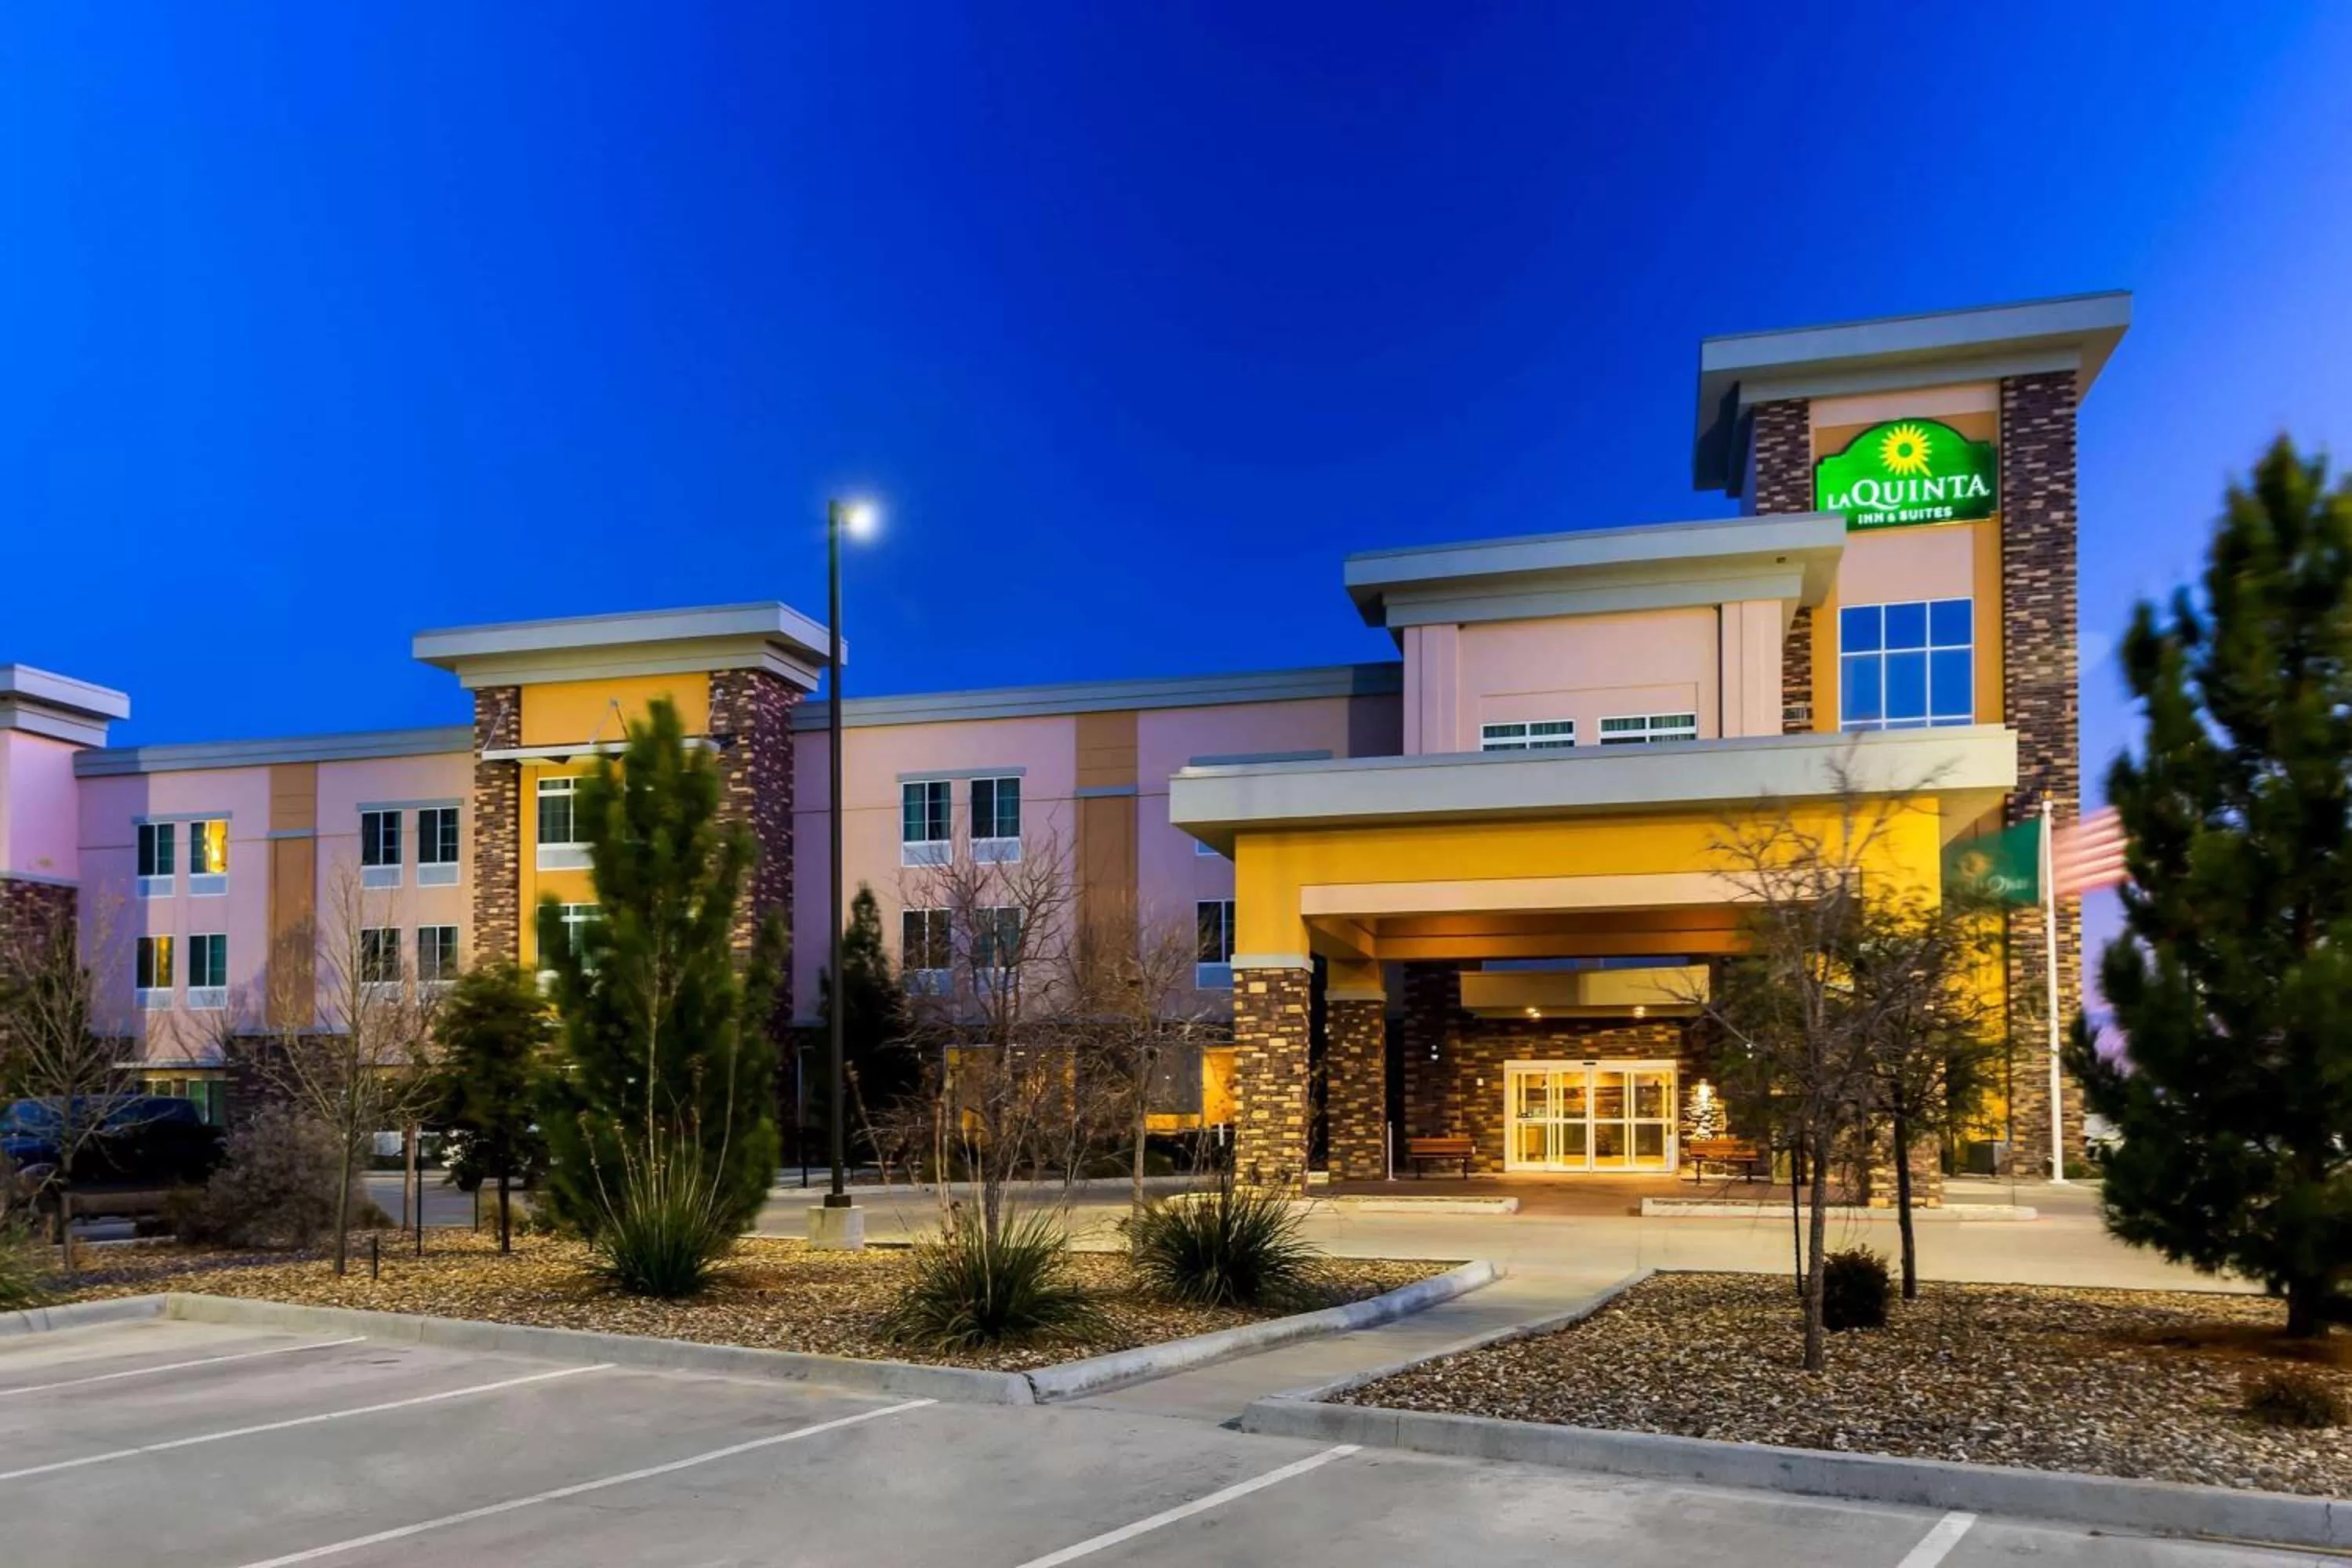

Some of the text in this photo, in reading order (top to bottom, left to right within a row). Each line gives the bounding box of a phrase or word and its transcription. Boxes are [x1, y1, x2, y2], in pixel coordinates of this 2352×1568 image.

[1828, 474, 1990, 510] LA QUINTA
[1858, 506, 1953, 524] INN & SUITES
